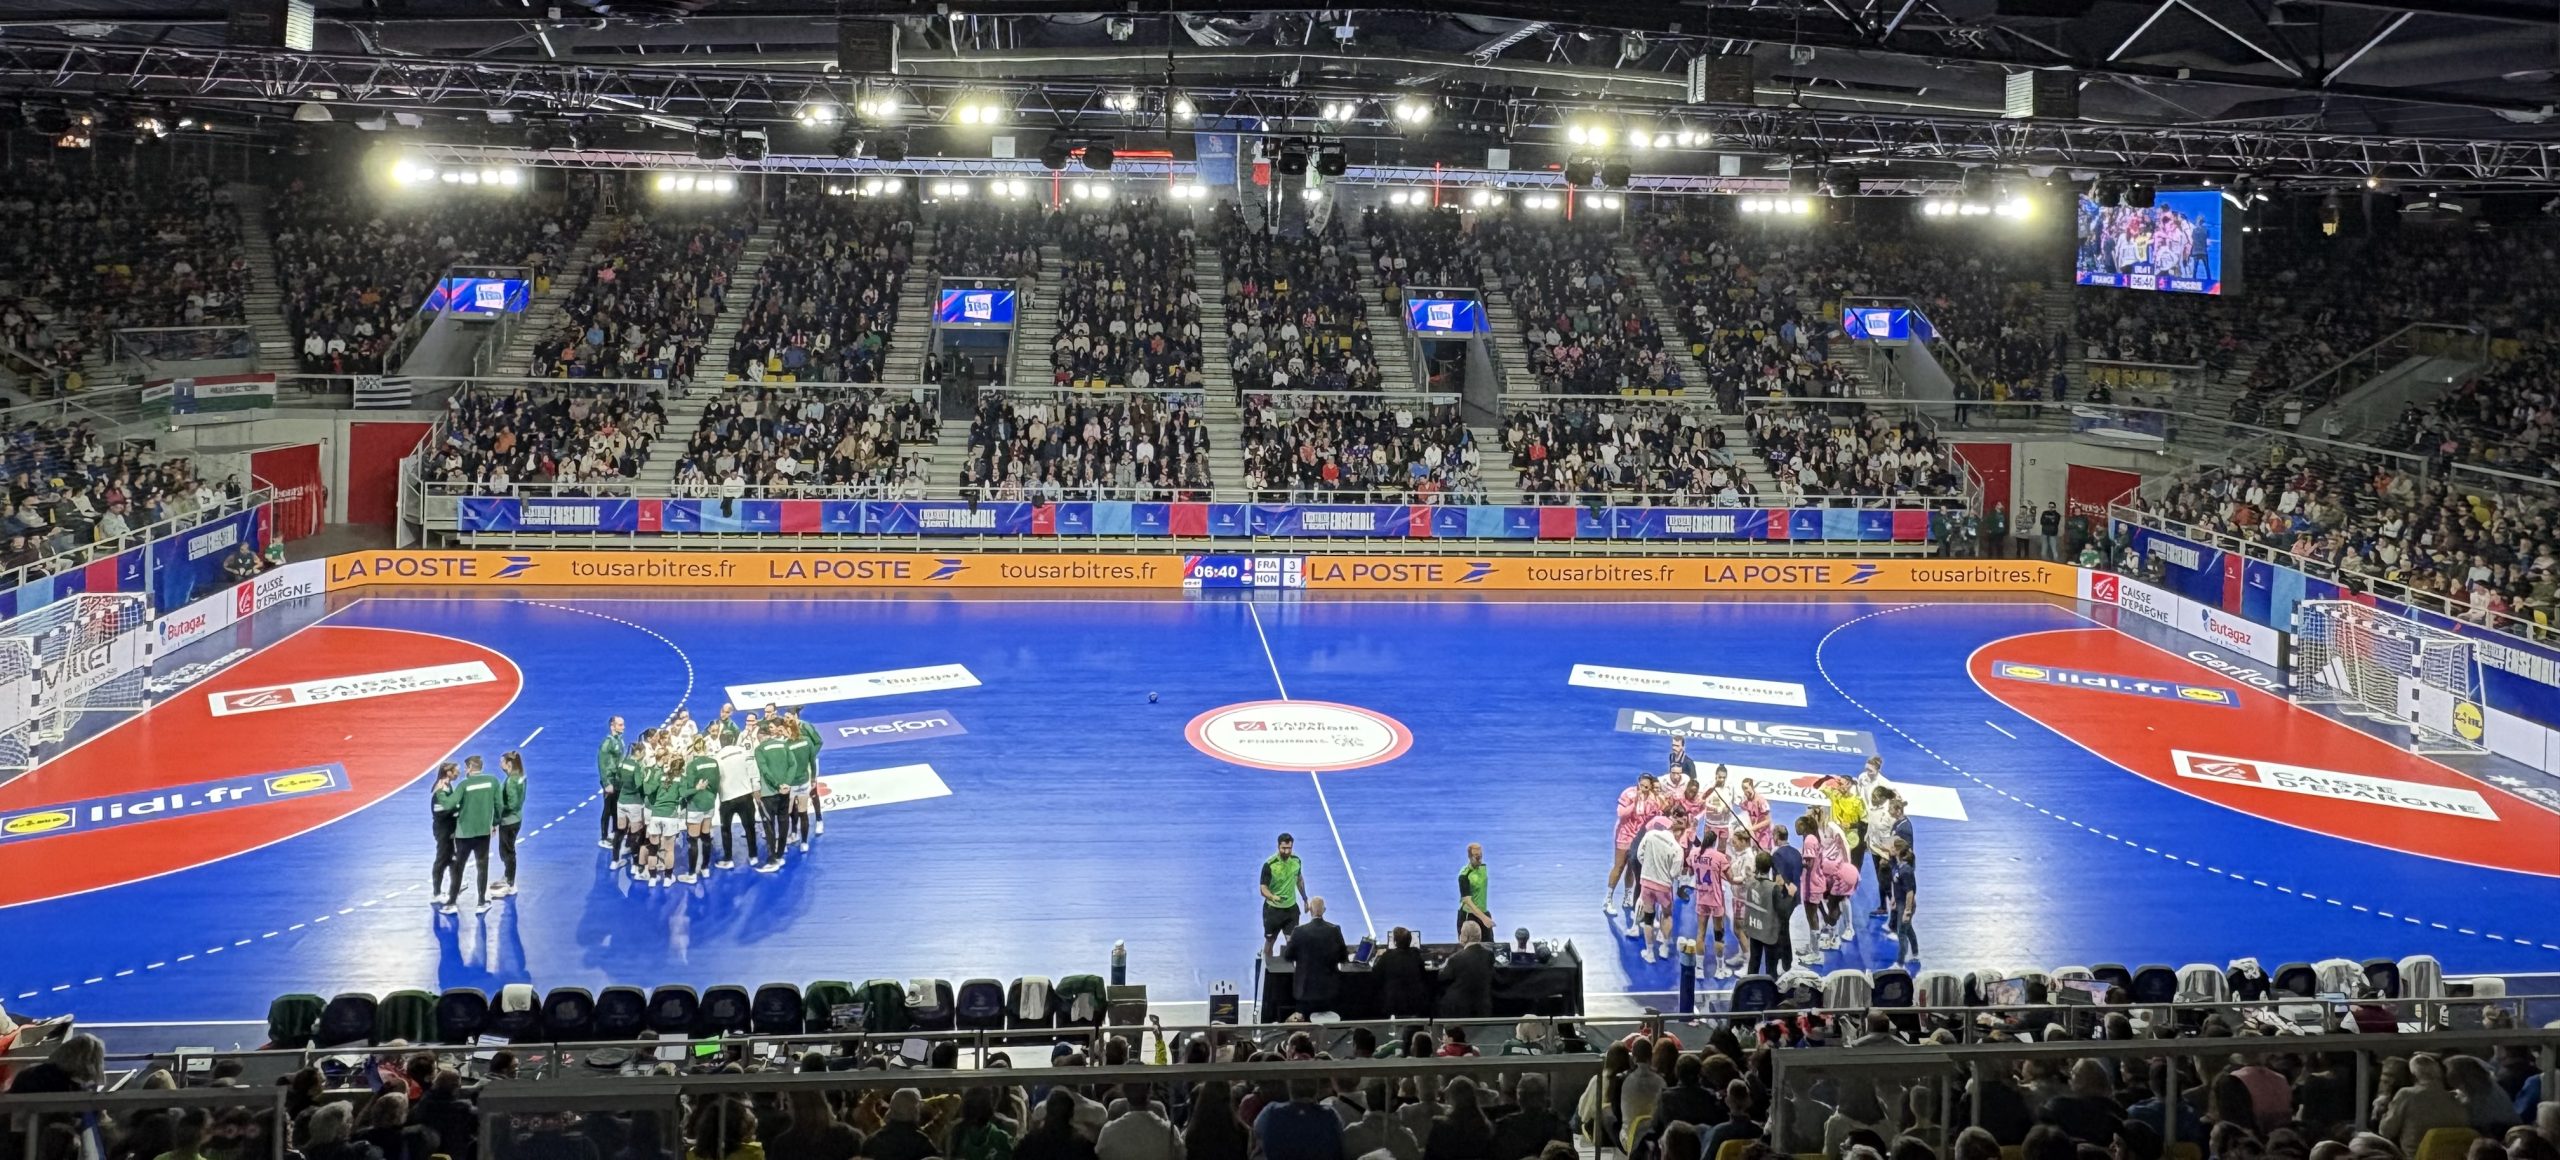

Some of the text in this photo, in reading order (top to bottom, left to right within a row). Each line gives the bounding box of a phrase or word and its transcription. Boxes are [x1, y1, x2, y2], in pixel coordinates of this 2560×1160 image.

[332, 557, 477, 582] LA POSTE
[572, 559, 736, 578] tousarbitres.fr
[769, 560, 911, 579] LA POSTE
[1000, 561, 1157, 580] tousarbitres.fr
[1194, 566, 1238, 578] 06:40
[1257, 561, 1296, 570] FRA 3
[1311, 563, 1443, 582] LA POSTE
[1527, 564, 1675, 582] tousarbitres.fr
[1704, 565, 1831, 583] LA POSTE
[1910, 565, 2051, 584] tousarbitres.fr
[1256, 574, 1296, 584] HON 5
[2121, 585, 2151, 604] CAISSE
[2121, 598, 2169, 623] D'EPARGNE
[168, 613, 206, 641] Butagaz
[2210, 620, 2251, 645] Butagaz
[2187, 651, 2286, 691] Gerflor
[2058, 672, 2168, 694] lidl.fr
[1632, 710, 1858, 743] MILLET
[2272, 771, 2397, 796] CAISSE
[91, 785, 253, 822] lidl.fr
[2277, 779, 2480, 815] D'EPARGNE
[1696, 868, 1712, 886] 14
